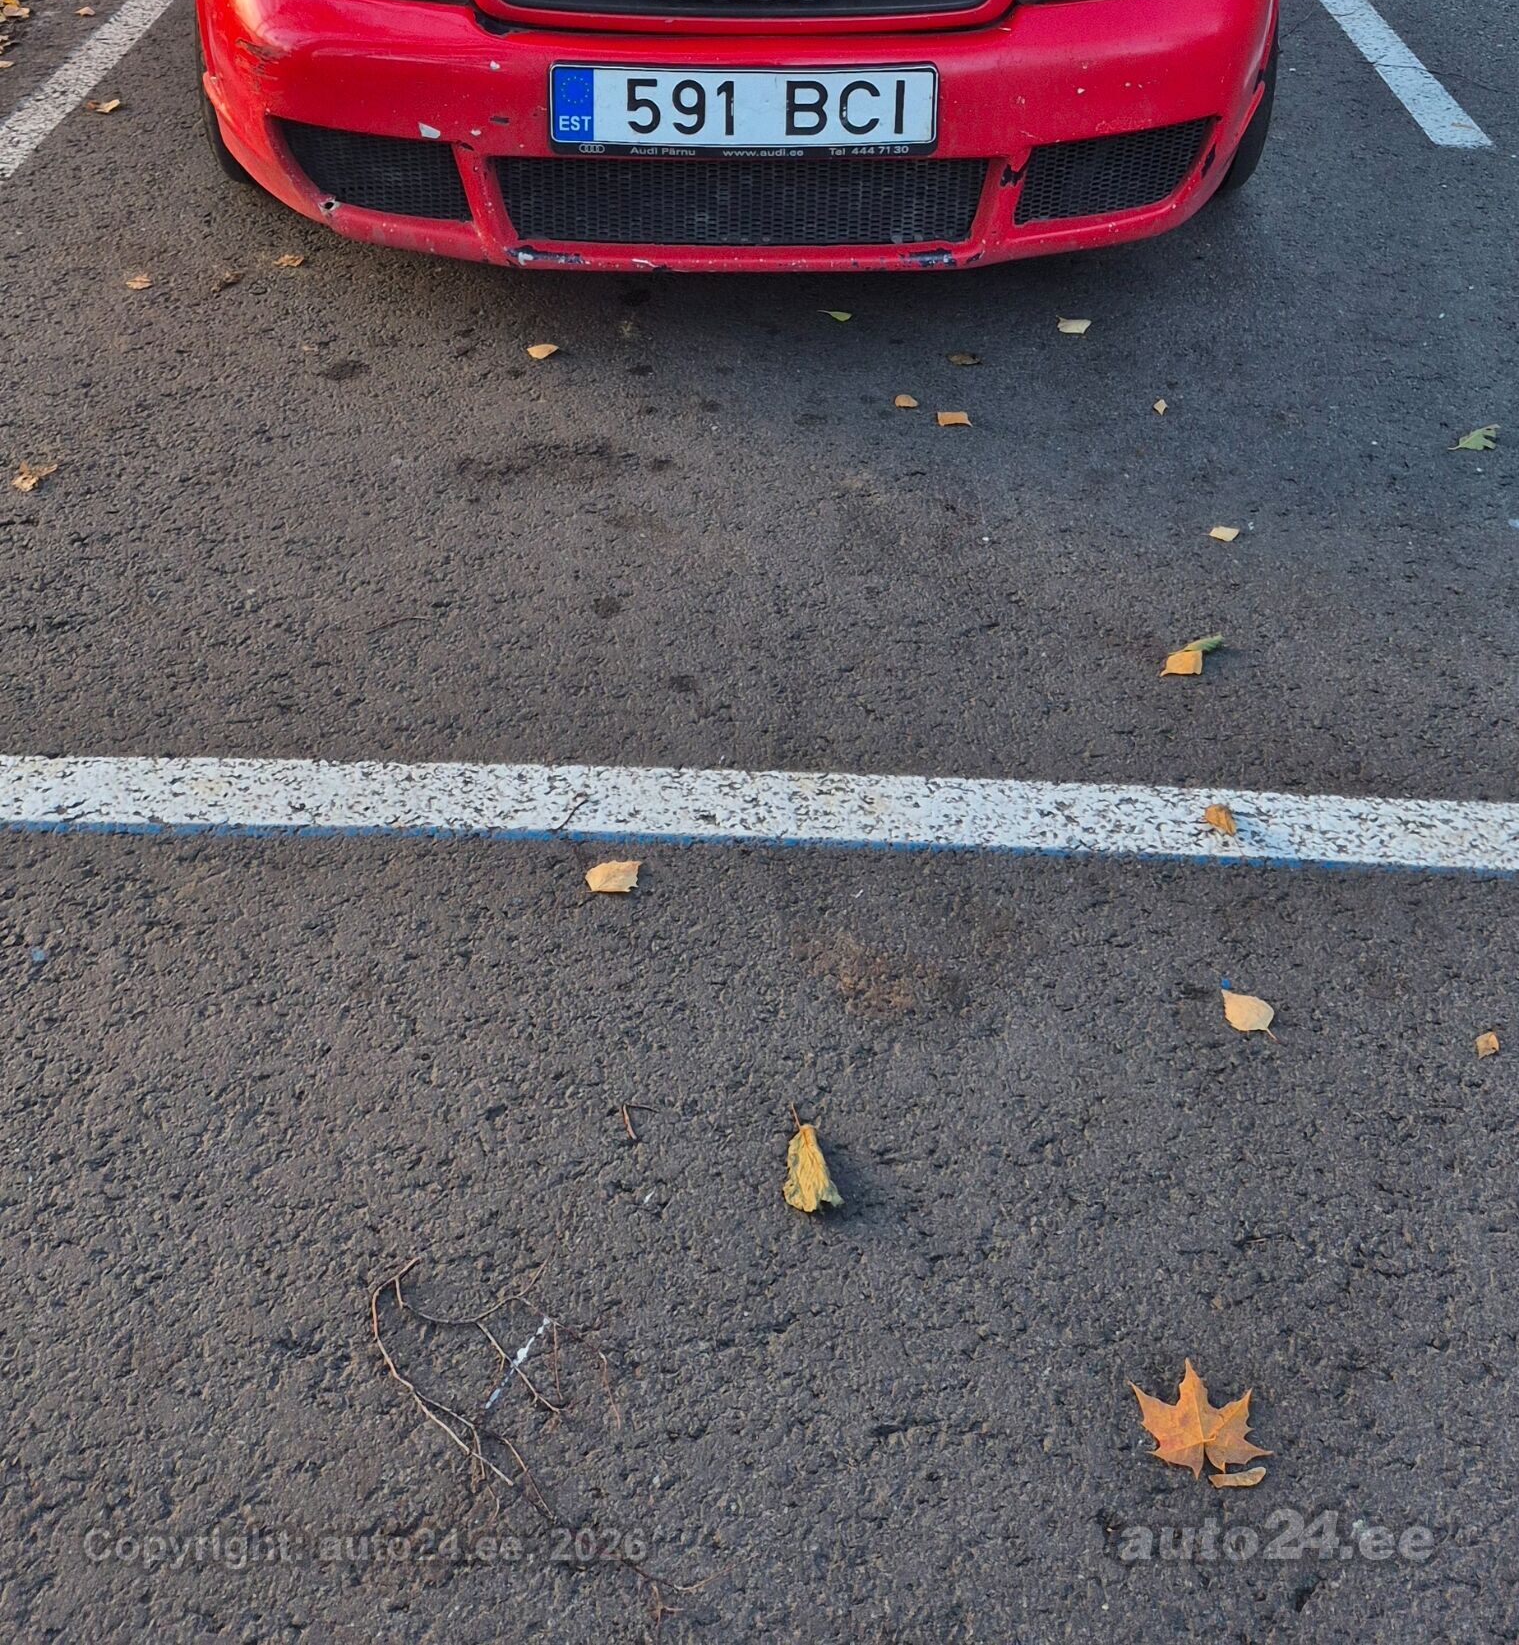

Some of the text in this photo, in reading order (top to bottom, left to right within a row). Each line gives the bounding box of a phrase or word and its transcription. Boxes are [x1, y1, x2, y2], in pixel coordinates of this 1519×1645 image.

[626, 78, 906, 136] 591 BCI
[558, 115, 592, 132] EST
[629, 146, 696, 156] Audi Pärnu
[829, 145, 910, 156] Tel 444 71 30
